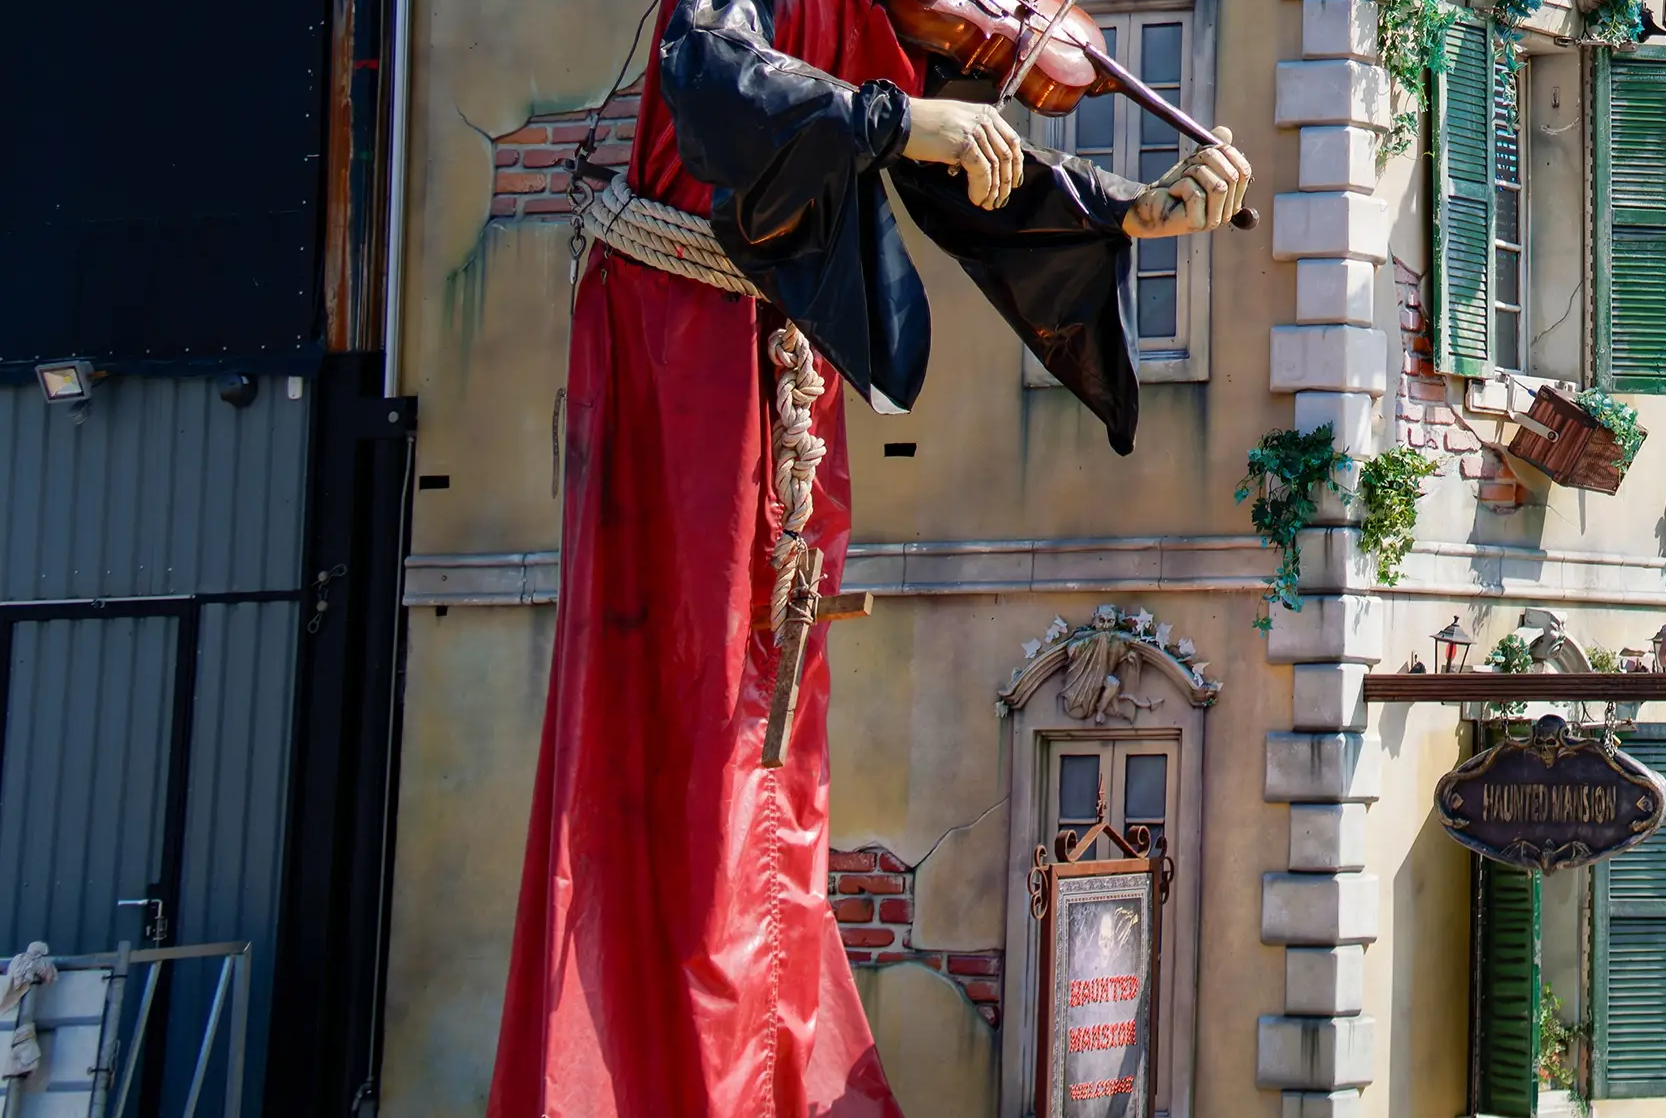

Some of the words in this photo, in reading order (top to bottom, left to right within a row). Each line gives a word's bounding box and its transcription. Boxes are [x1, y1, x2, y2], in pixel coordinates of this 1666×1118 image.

[1482, 783, 1549, 823] HAUNTED
[1552, 784, 1617, 824] MANSION
[1069, 975, 1140, 1007] HAUNTED
[1068, 1019, 1137, 1054] MANSION
[1069, 1075, 1135, 1101] WELCOME
